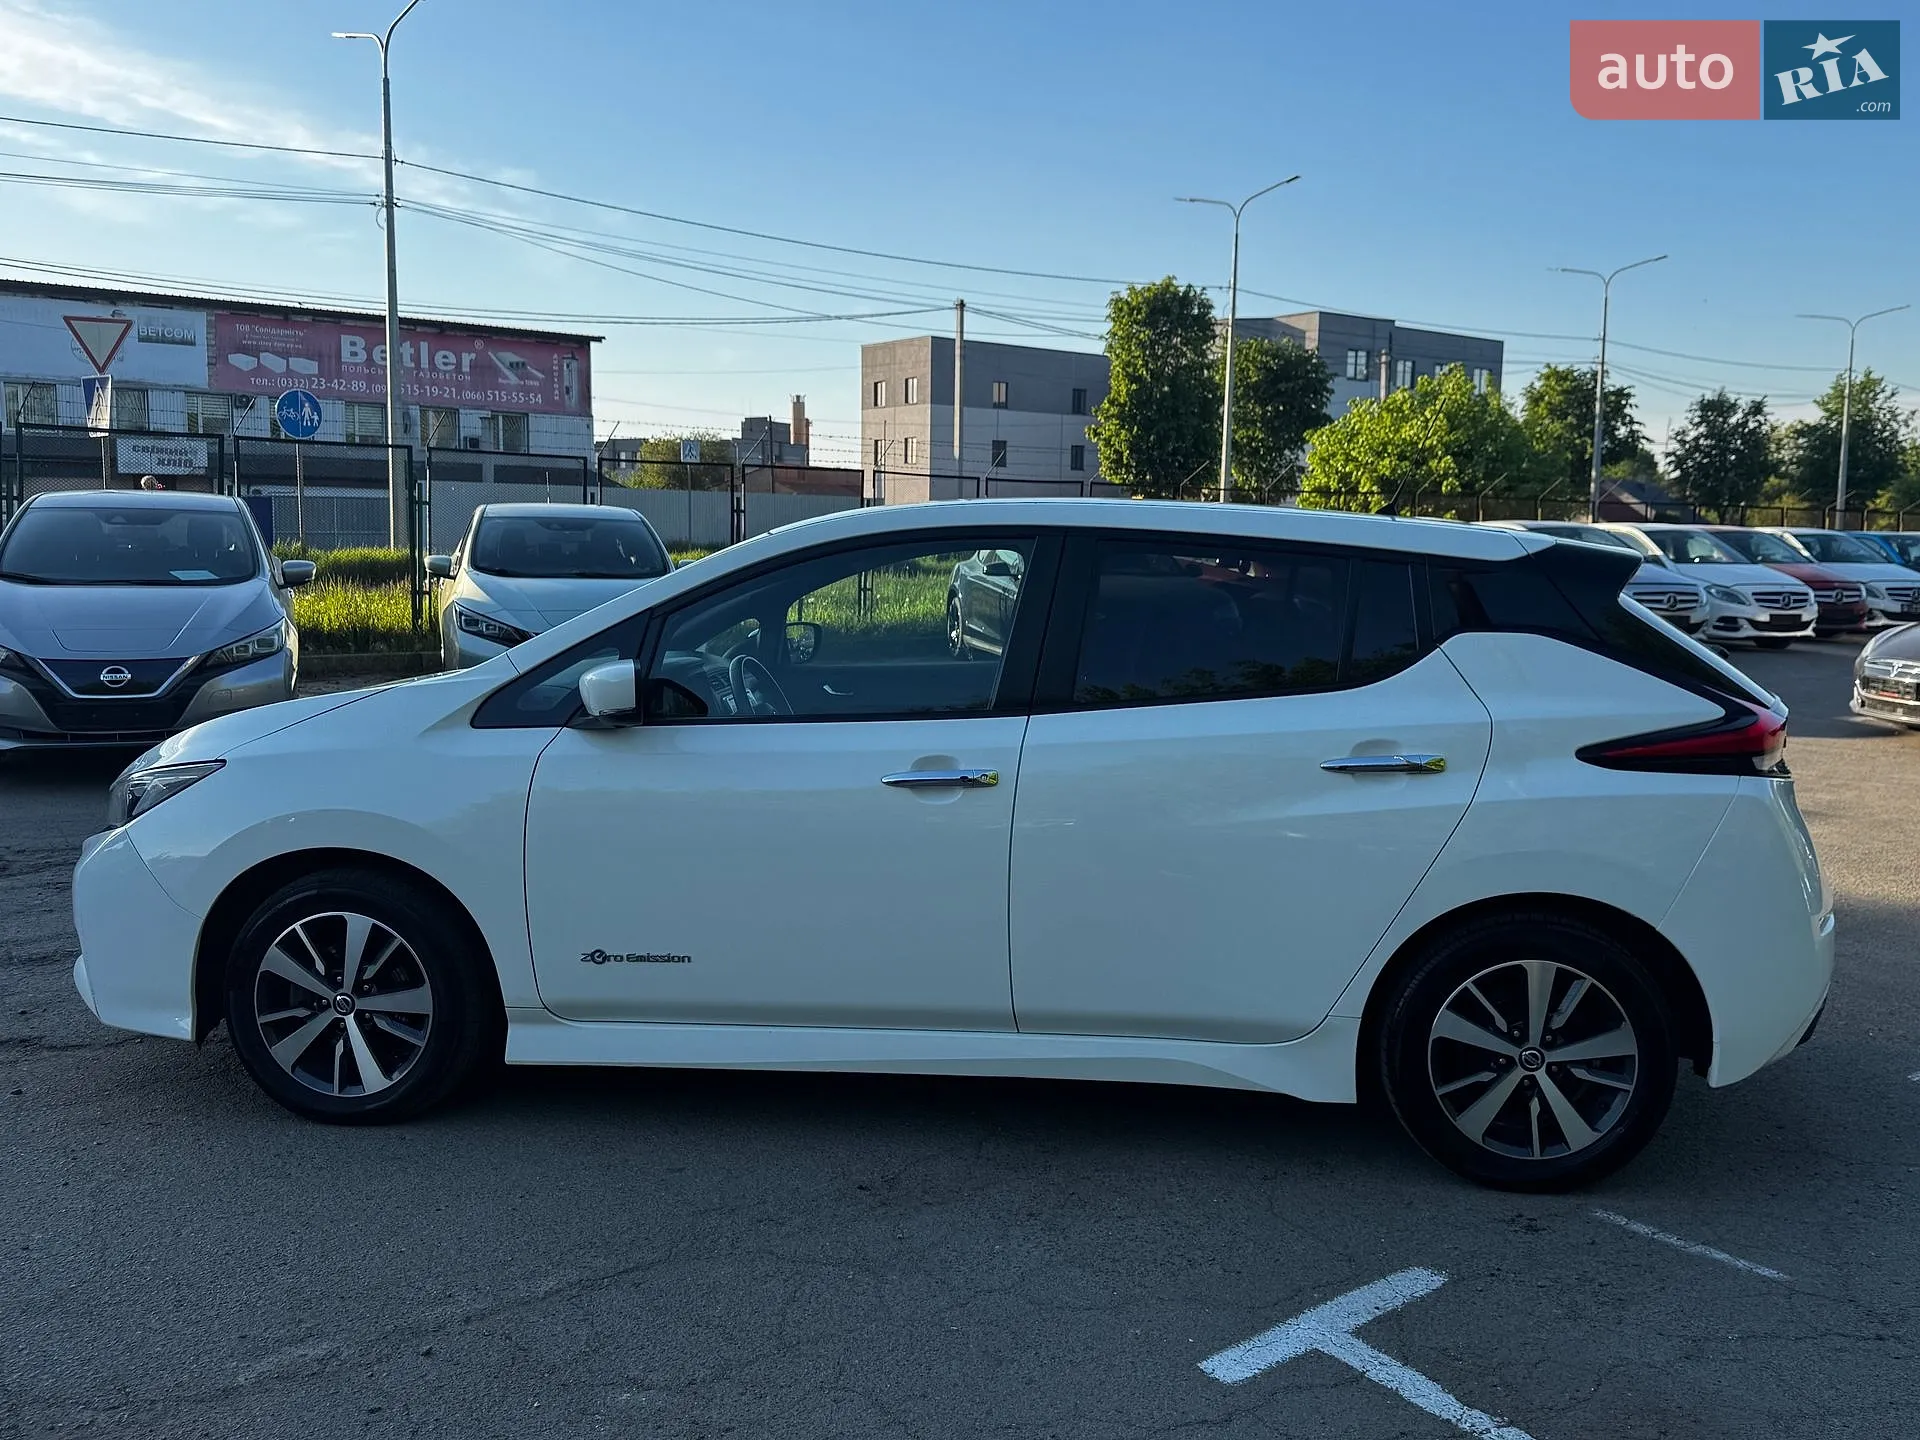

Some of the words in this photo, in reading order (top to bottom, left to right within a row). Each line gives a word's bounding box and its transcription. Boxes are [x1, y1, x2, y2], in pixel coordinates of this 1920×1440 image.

[340, 334, 476, 373] Betler
[277, 378, 309, 390] (0332)
[462, 390, 485, 401] (066)
[487, 390, 543, 405] 515-55-54
